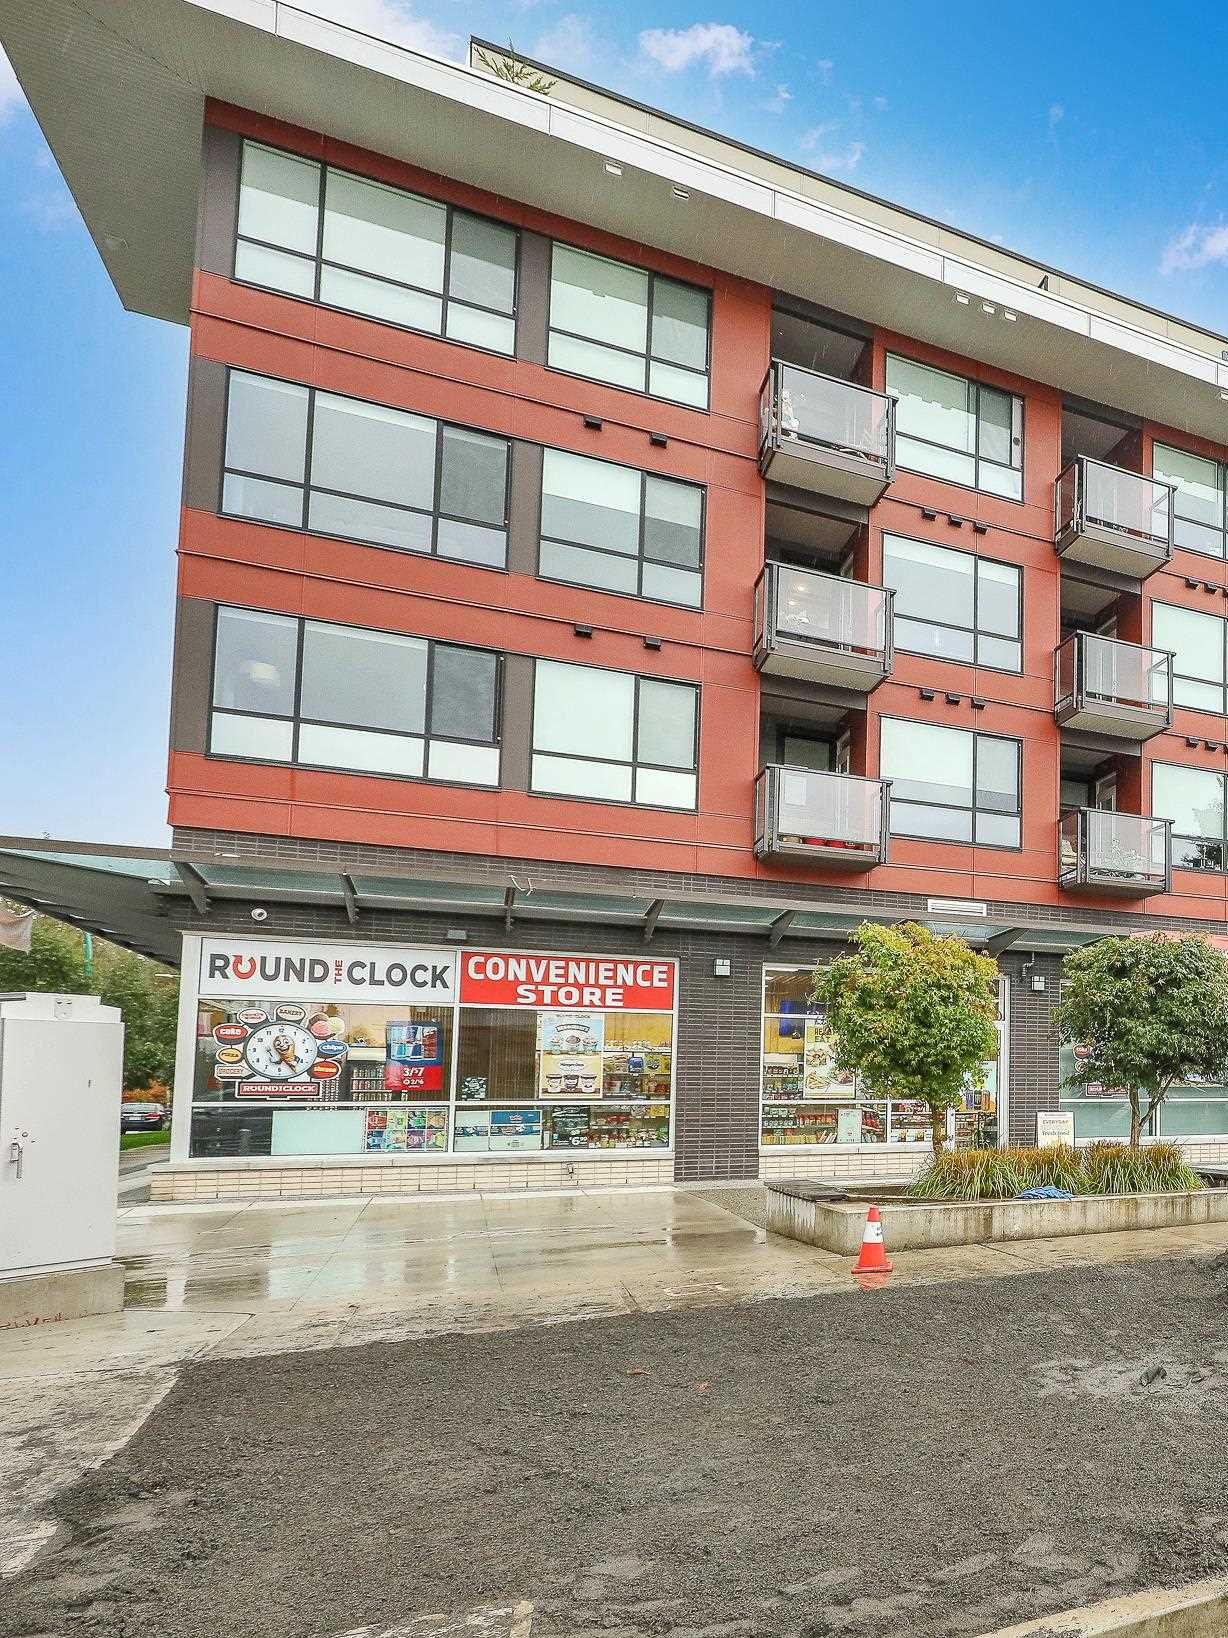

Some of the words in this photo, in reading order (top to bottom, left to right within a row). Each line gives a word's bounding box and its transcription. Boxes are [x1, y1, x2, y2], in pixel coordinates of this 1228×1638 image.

[208, 953, 330, 984] ROUND
[334, 959, 343, 985] THE
[346, 960, 450, 989] CLOCK
[467, 955, 669, 988] CONVENIENCE
[516, 984, 625, 1006] STORE
